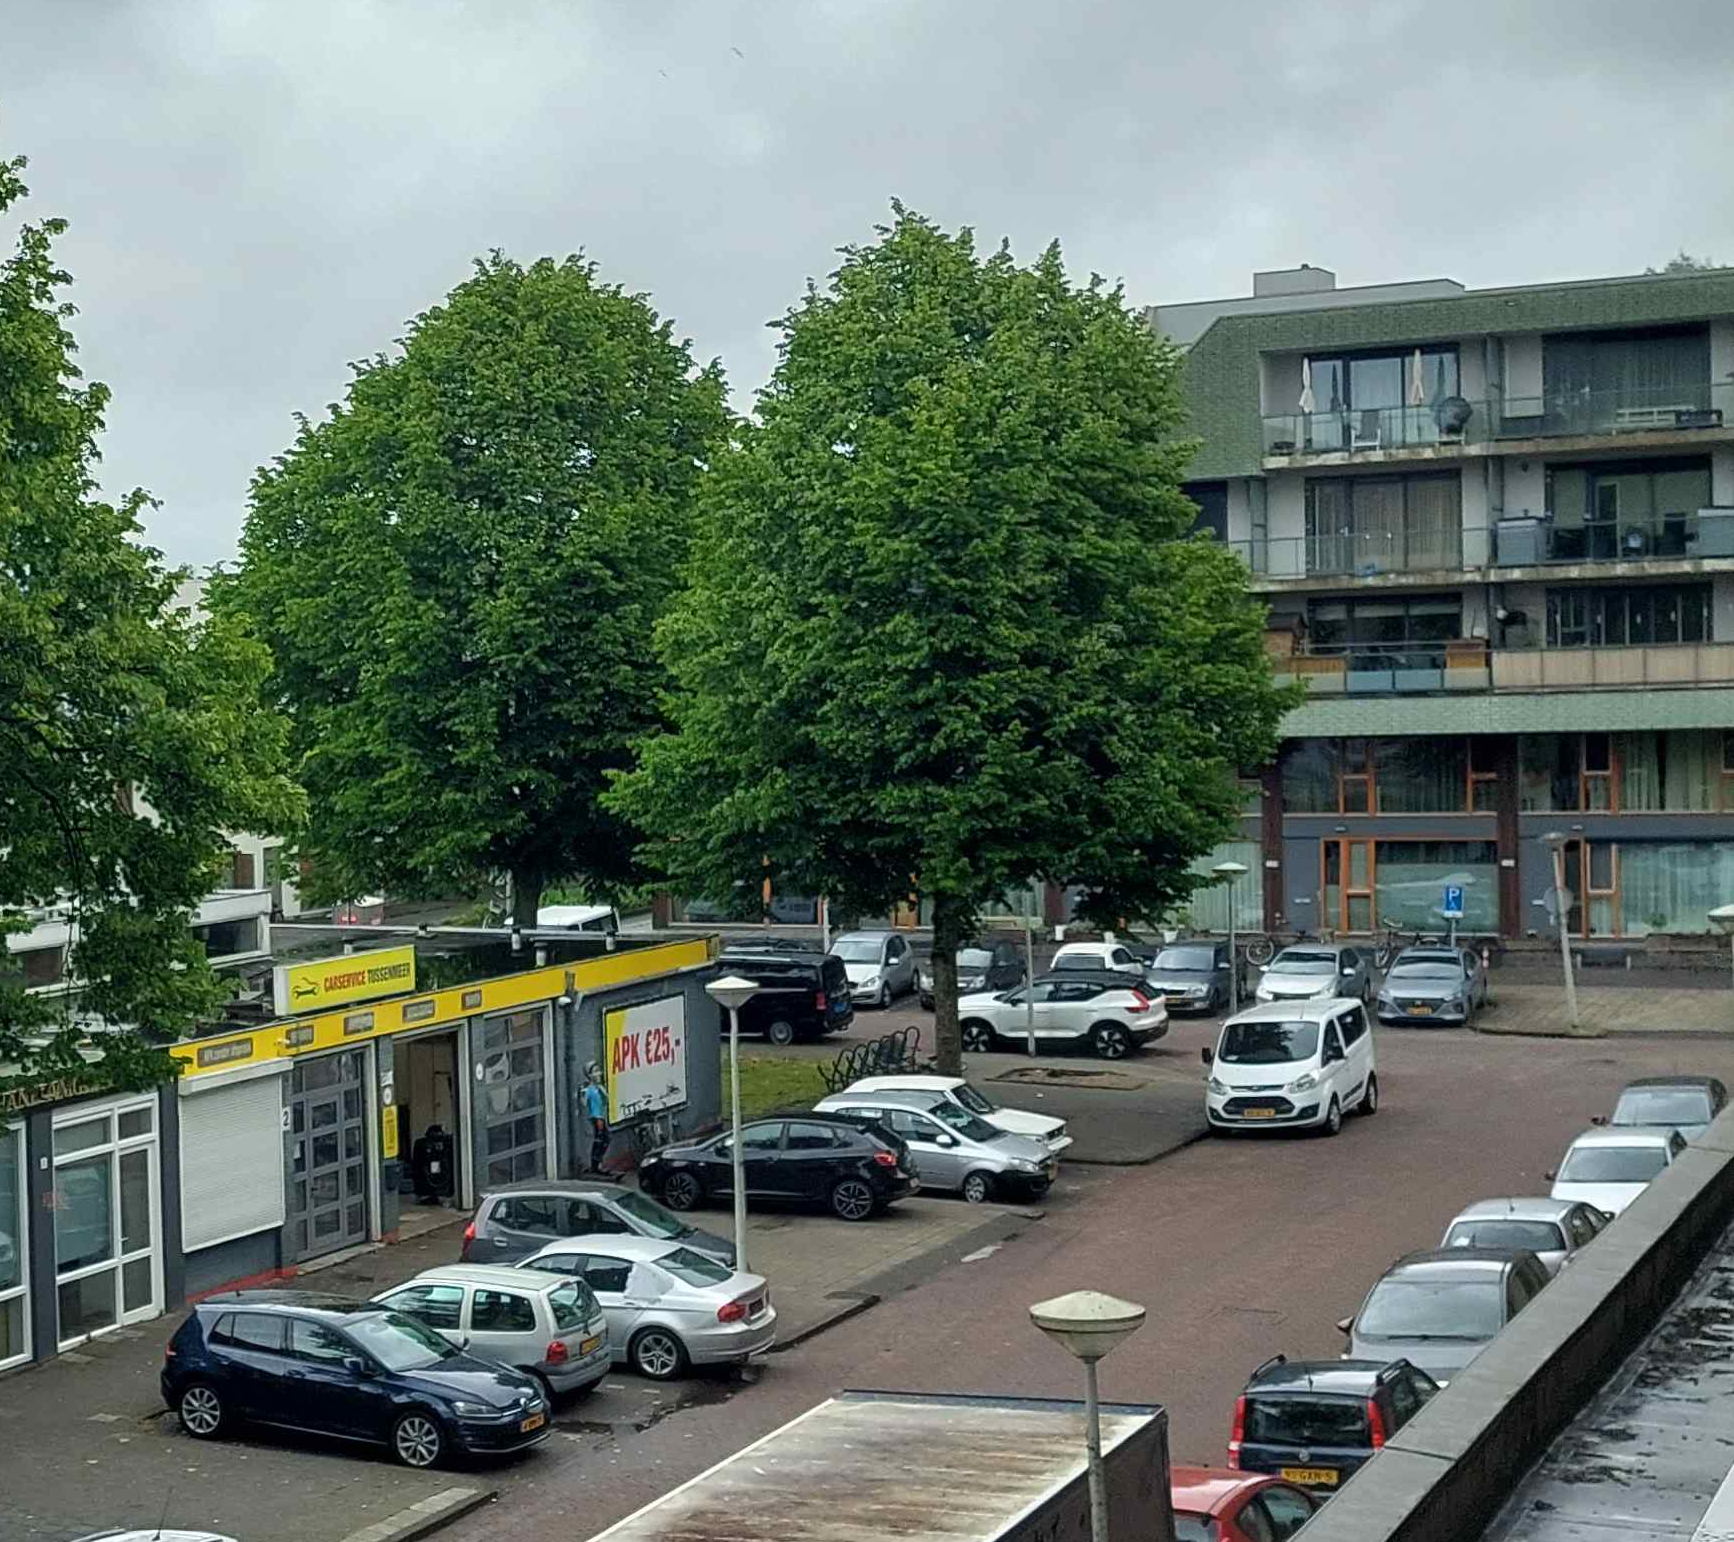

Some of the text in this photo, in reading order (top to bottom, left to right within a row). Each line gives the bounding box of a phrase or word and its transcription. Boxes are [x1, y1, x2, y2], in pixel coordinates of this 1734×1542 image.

[1449, 887, 1460, 901] P
[324, 962, 411, 992] CARSERVICE TUSSENMEER
[612, 1026, 681, 1075] APK €25,-
[283, 1110, 290, 1127] 2
